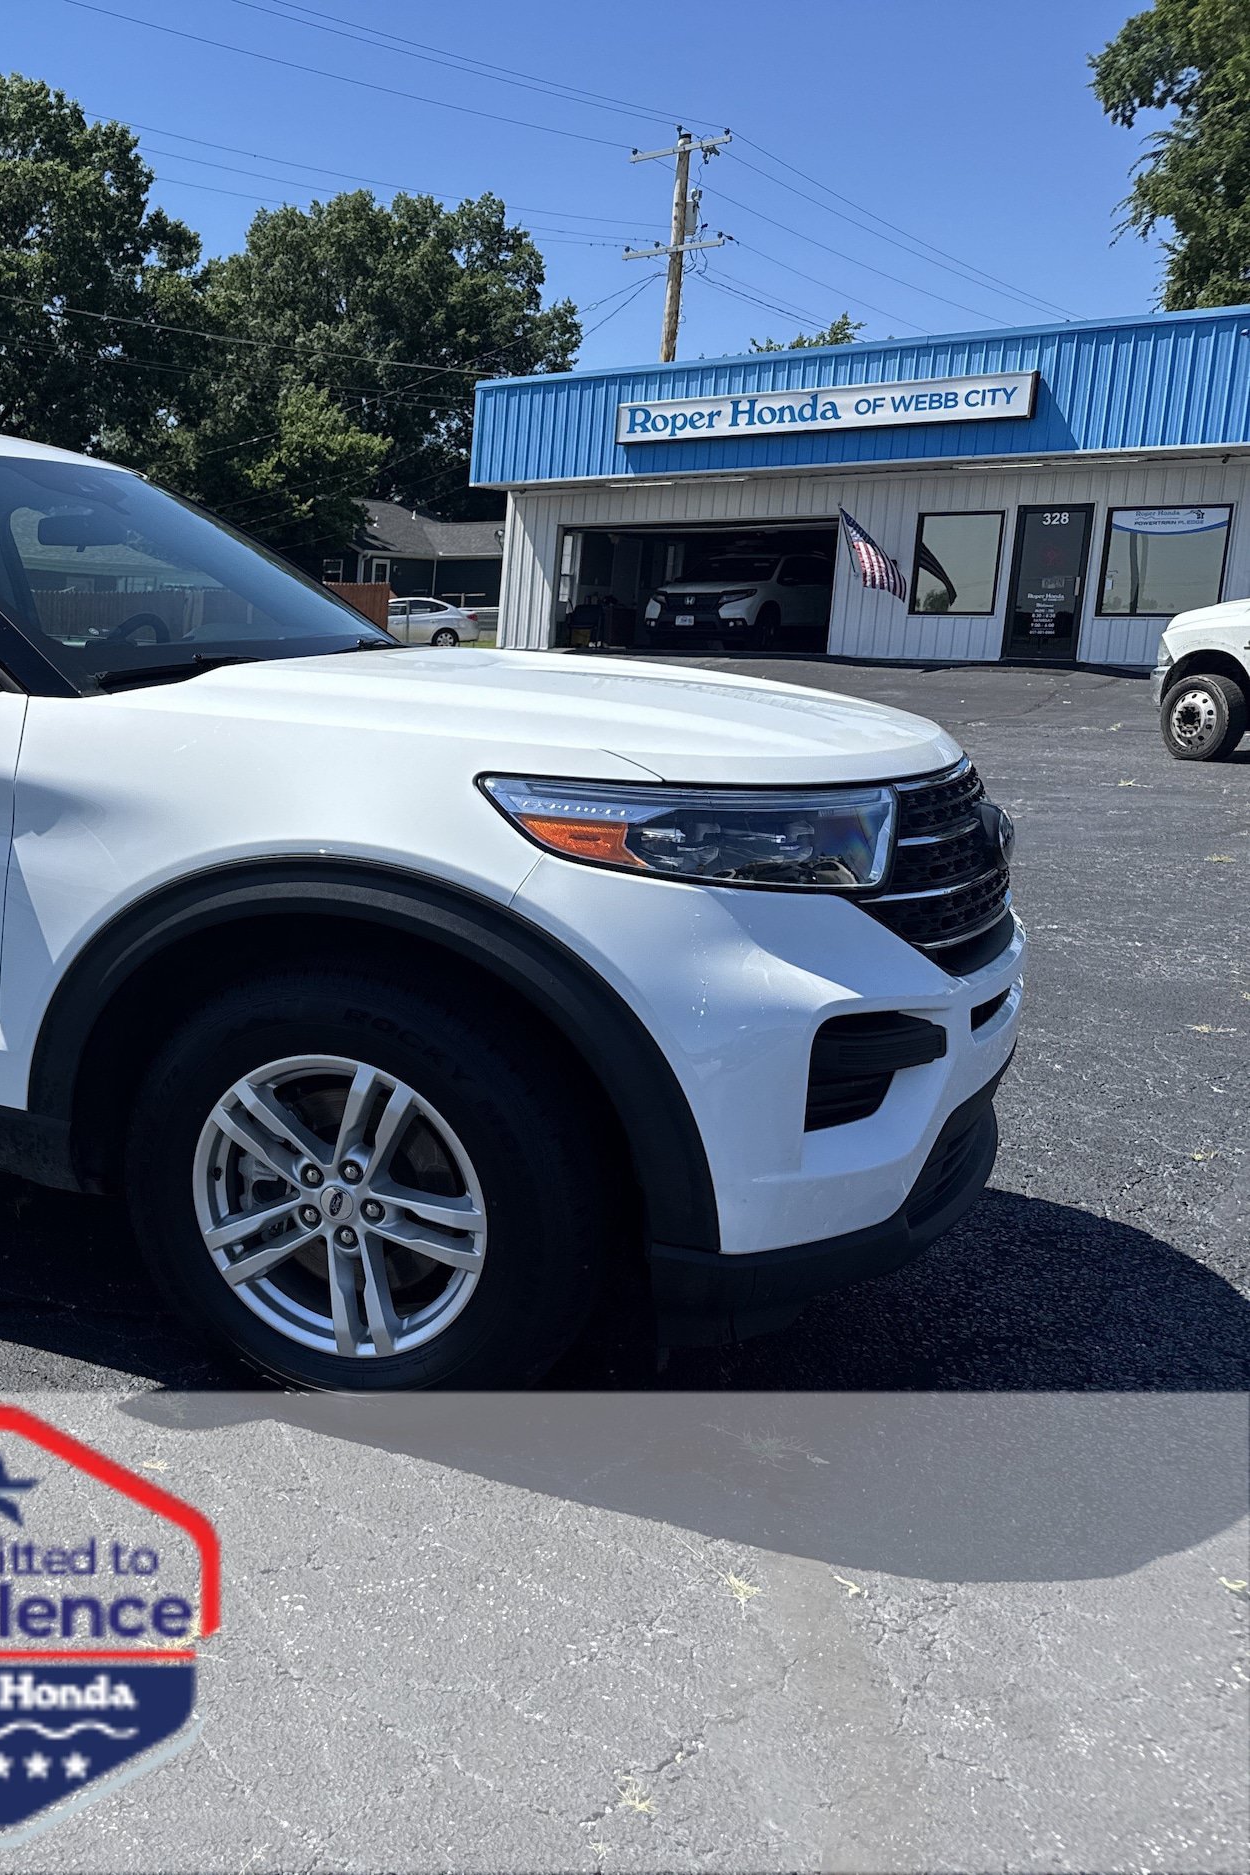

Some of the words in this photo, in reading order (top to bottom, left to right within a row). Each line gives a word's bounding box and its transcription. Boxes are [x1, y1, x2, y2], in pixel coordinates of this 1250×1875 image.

[626, 407, 722, 436] Roper
[729, 394, 841, 427] Honda
[854, 397, 885, 416] OF
[891, 392, 959, 413] WEBB
[964, 386, 1019, 408] CITY
[1042, 511, 1070, 525] 328
[1135, 510, 1157, 519] Roper
[1158, 509, 1180, 517] Honda
